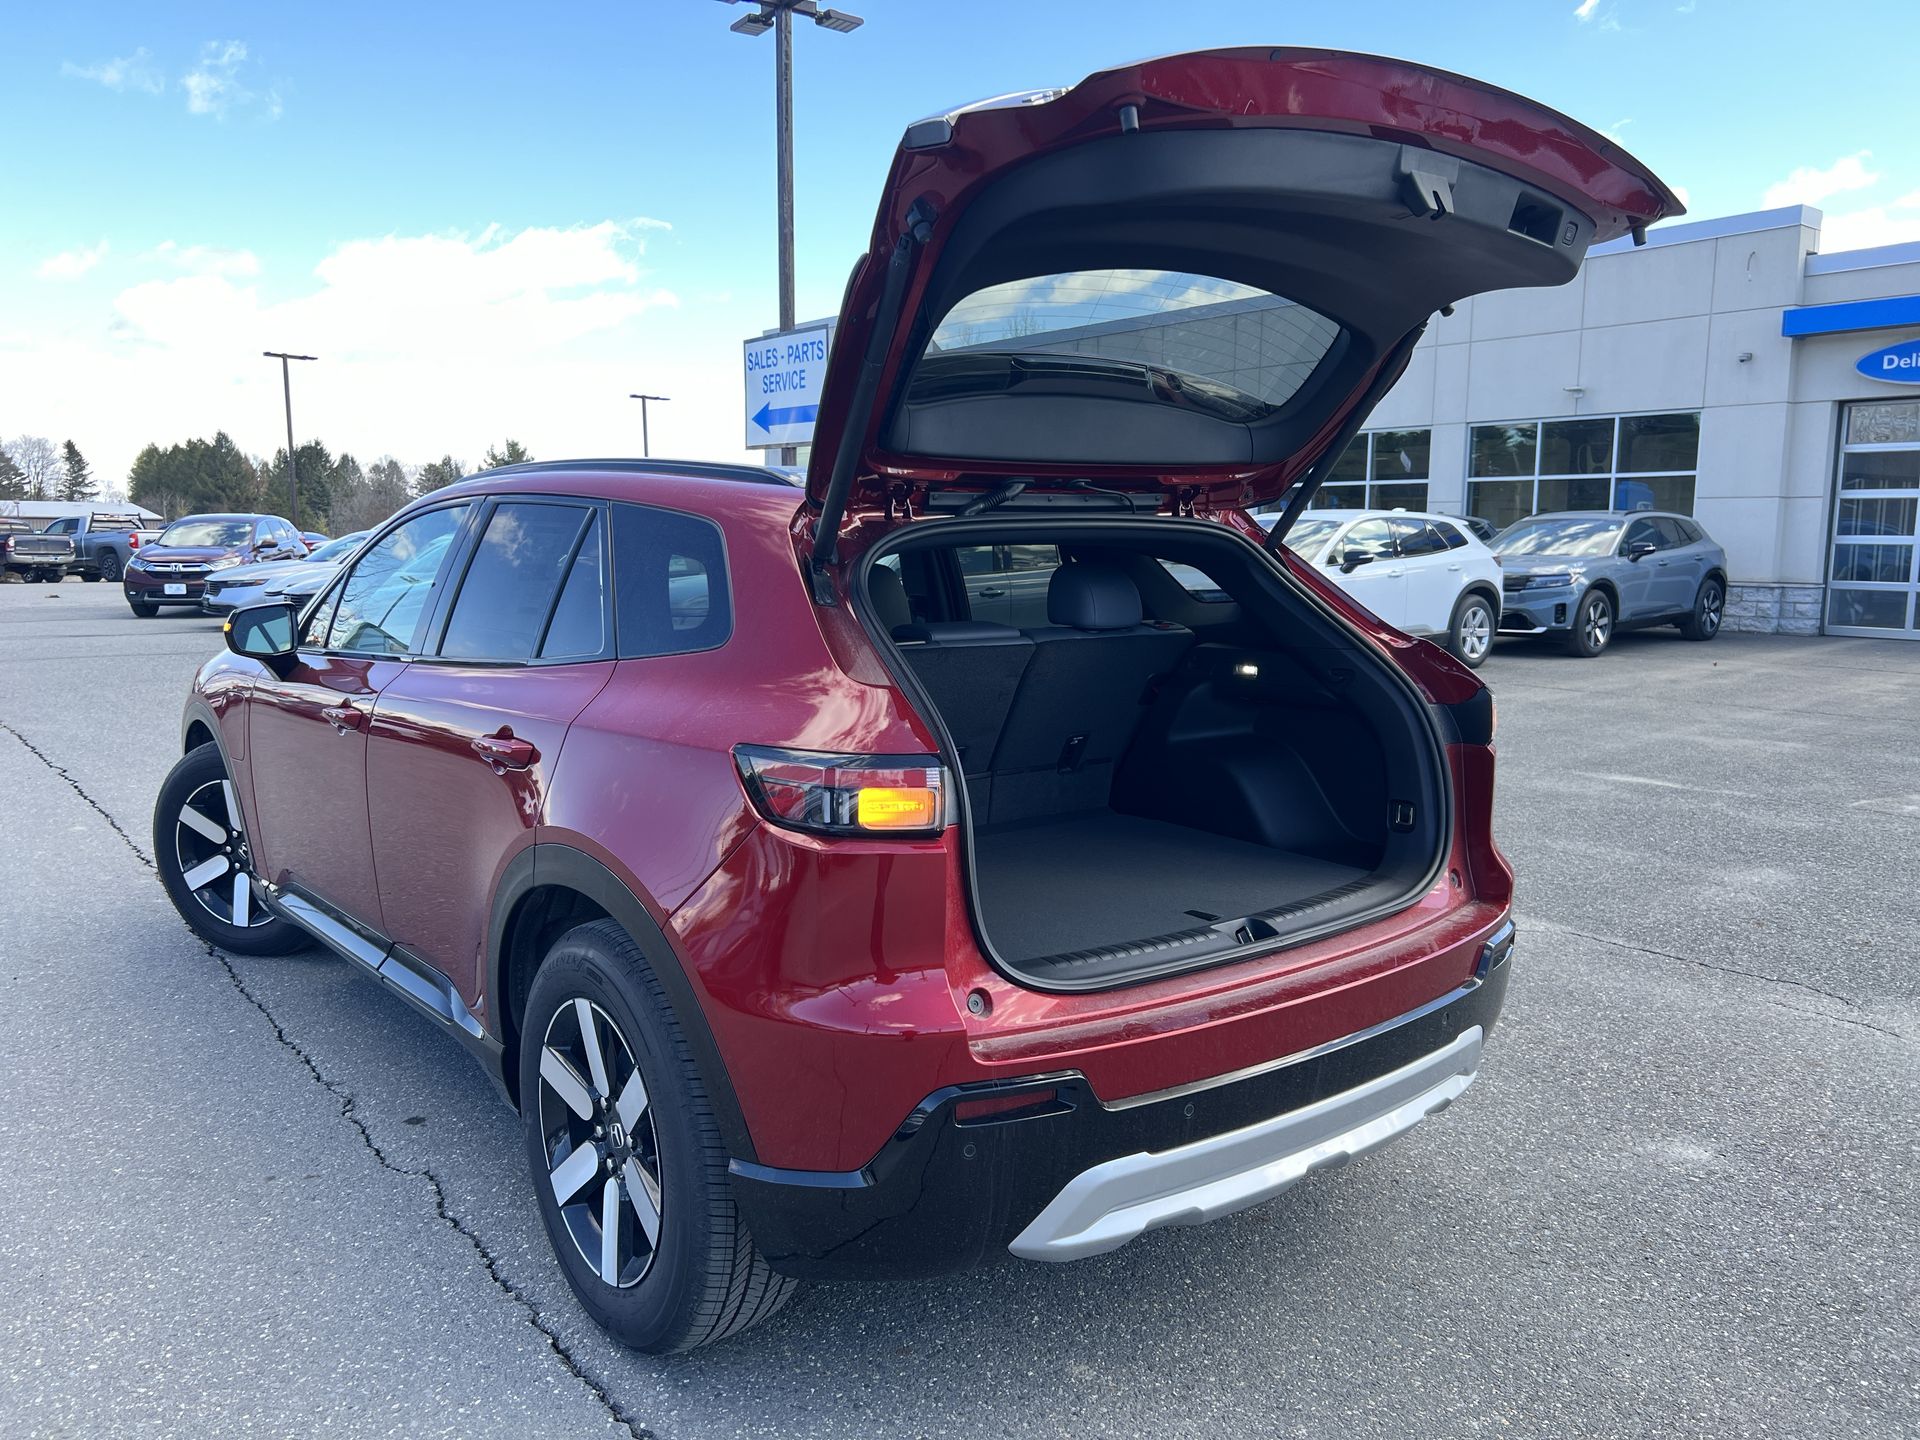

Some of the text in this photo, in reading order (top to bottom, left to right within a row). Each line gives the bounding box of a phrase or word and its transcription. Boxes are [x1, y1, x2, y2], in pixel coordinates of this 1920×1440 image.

[747, 347, 778, 372] SALES
[787, 340, 824, 365] PARTS
[762, 369, 806, 394] SERVICE
